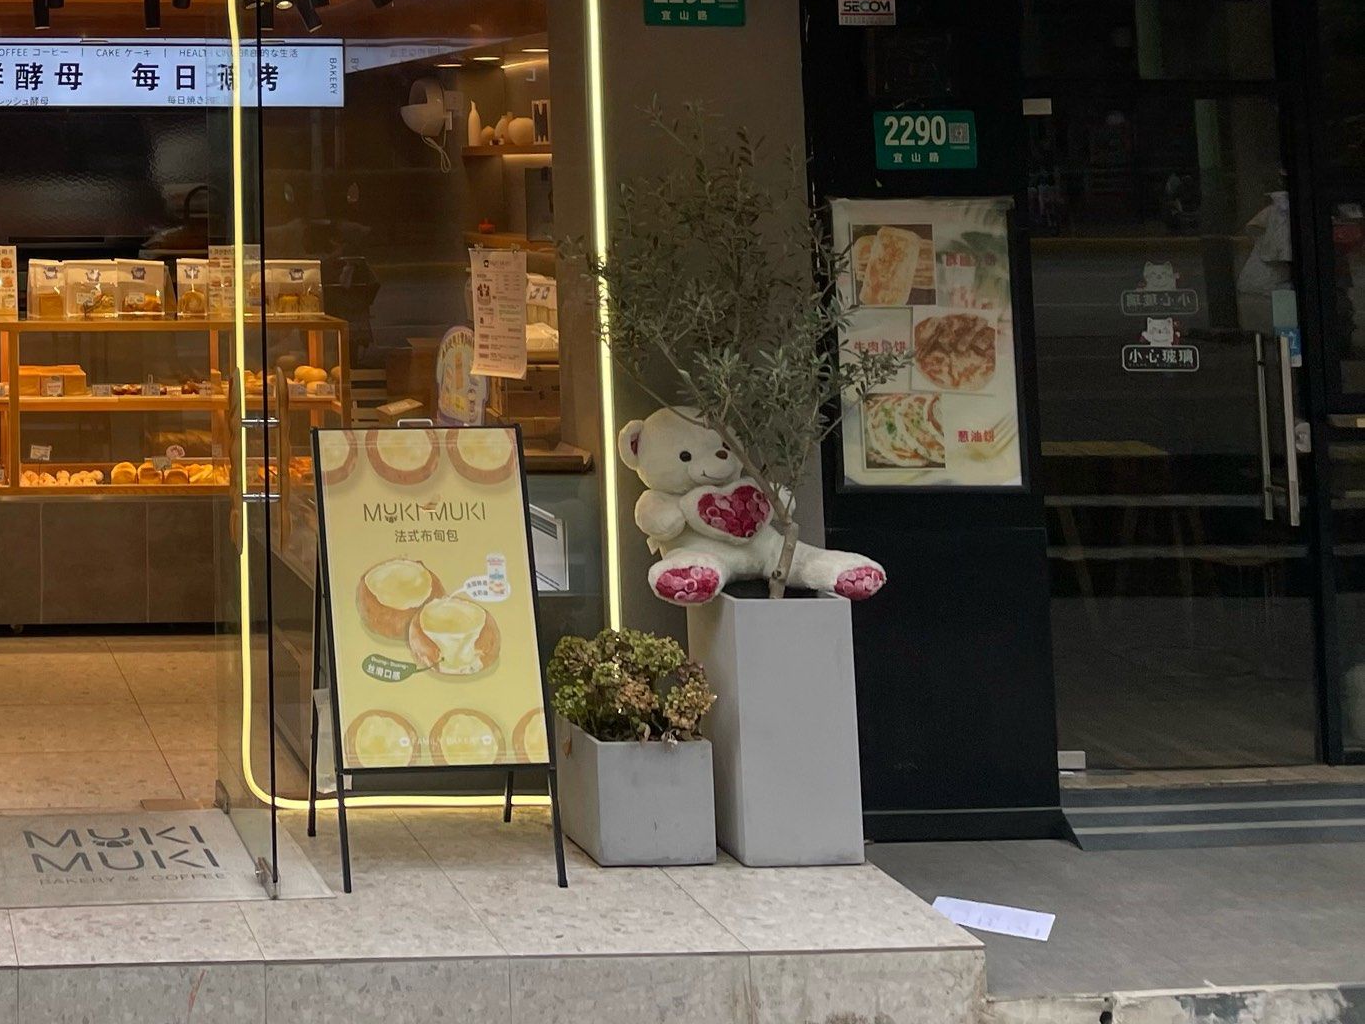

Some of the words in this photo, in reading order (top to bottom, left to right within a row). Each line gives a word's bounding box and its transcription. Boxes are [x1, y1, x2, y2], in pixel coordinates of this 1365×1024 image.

[843, 0, 891, 12] SECOM
[661, 9, 708, 21] 宜山路
[96, 49, 120, 57] CAKE
[125, 49, 152, 57] ケーキ
[328, 57, 338, 95] BAKERY
[884, 116, 947, 146] 2290
[892, 152, 939, 163] 宜山路
[1129, 349, 1193, 364] 小心玻璃
[363, 502, 422, 523] MUKI
[428, 502, 486, 521] MUKI
[394, 529, 459, 543] 法式布甸包
[23, 825, 205, 849] MUKI
[31, 848, 219, 873] MUKI
[40, 875, 115, 886] BAKERY
[151, 873, 226, 882] COFFEE
